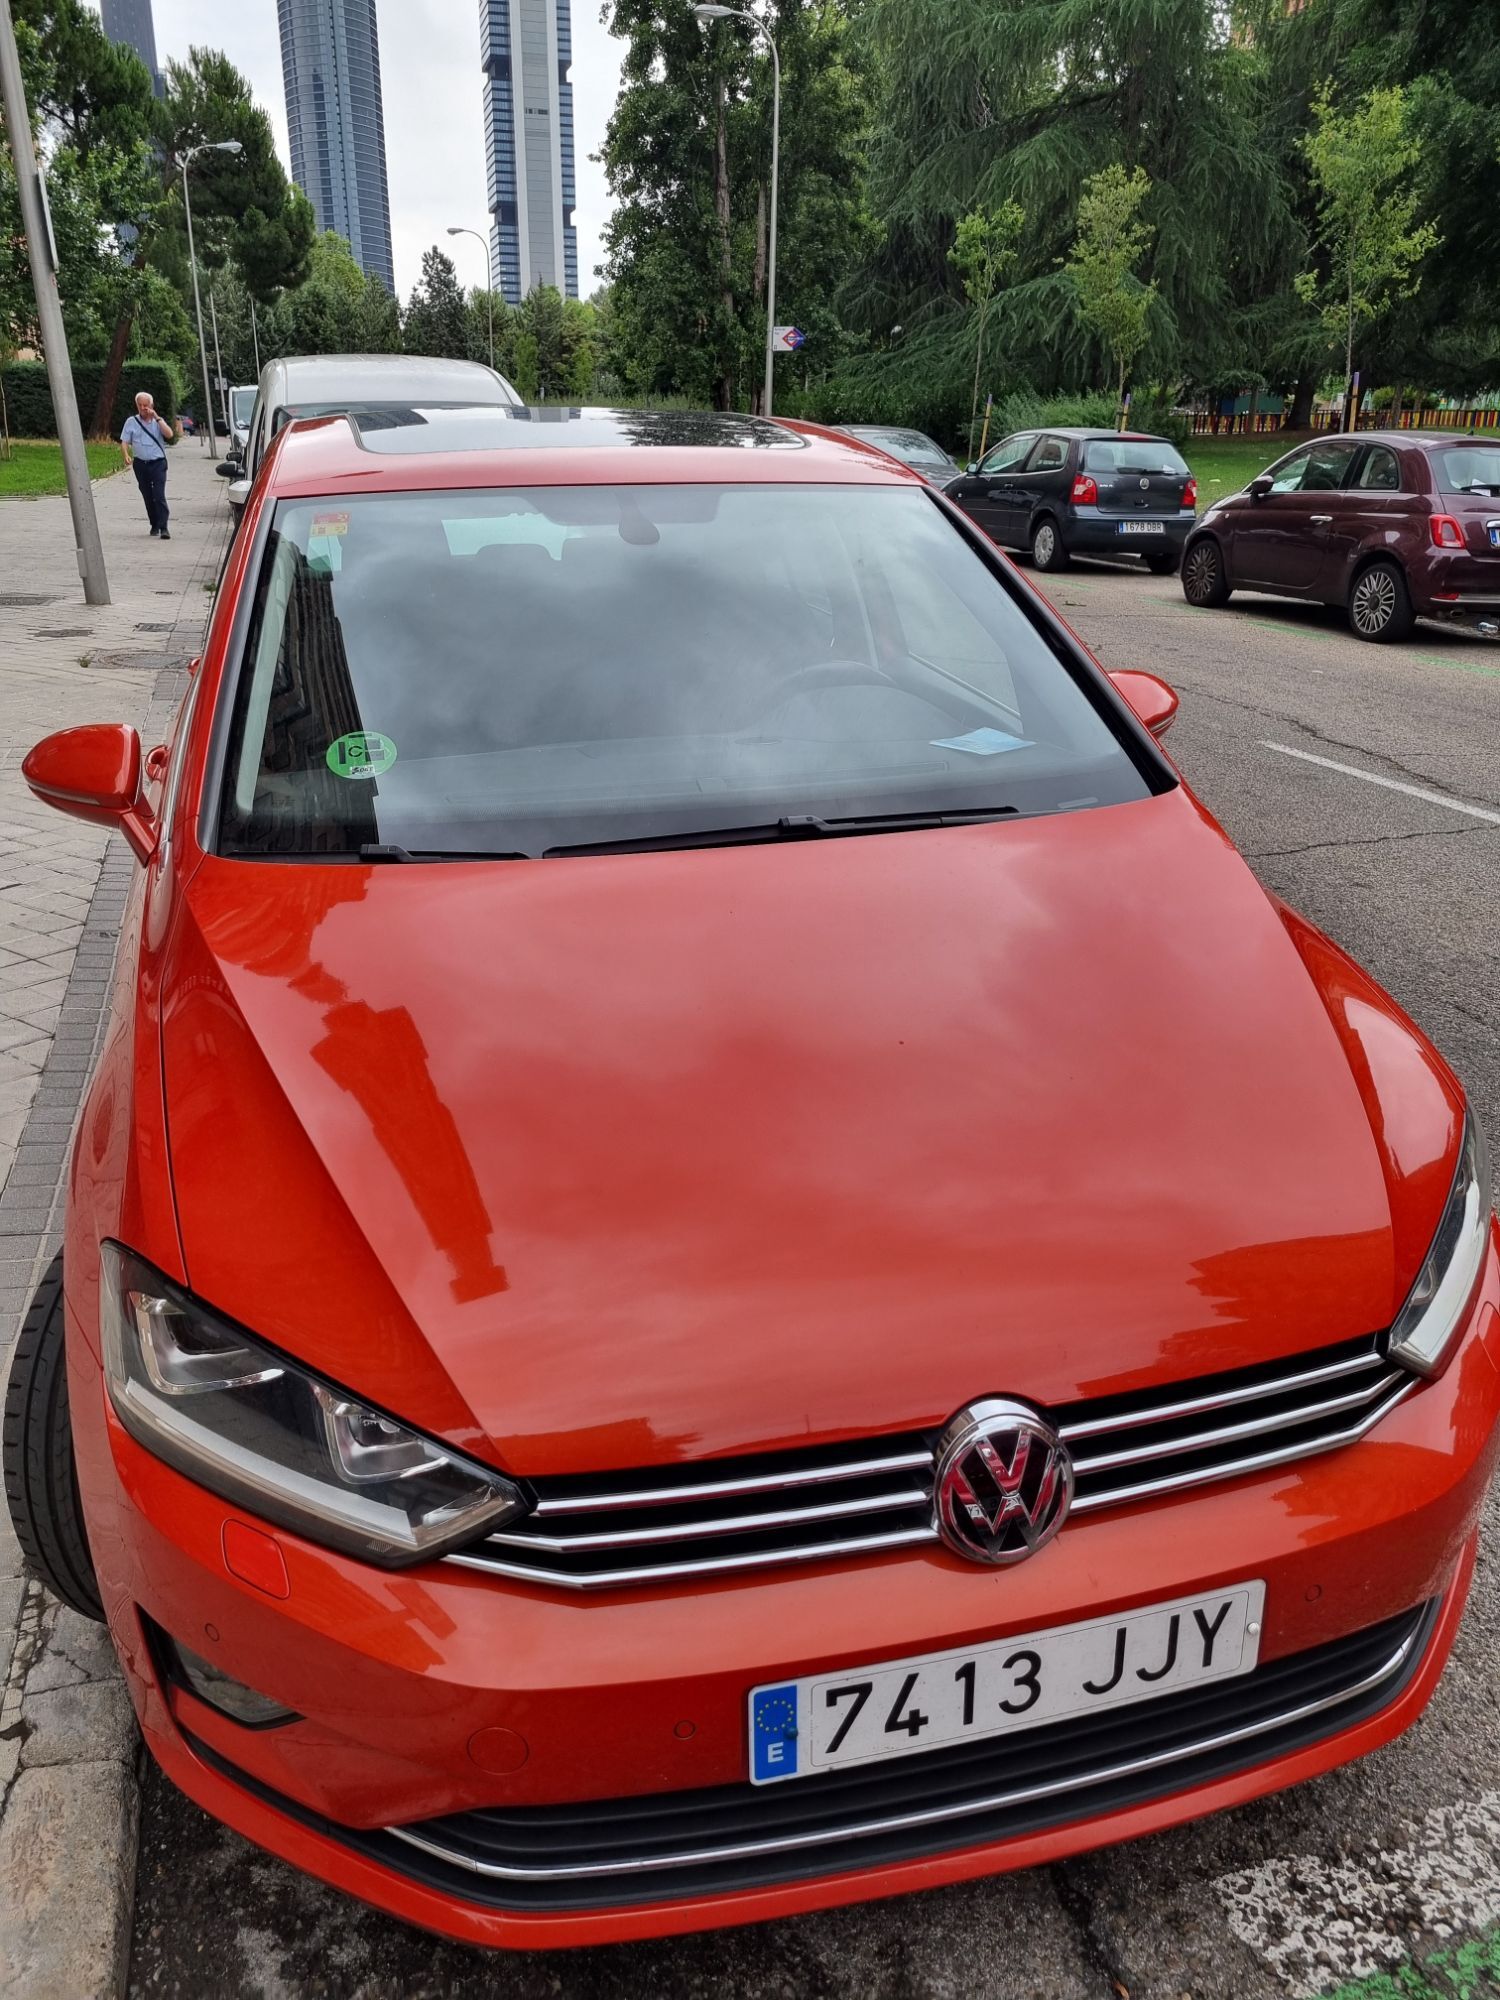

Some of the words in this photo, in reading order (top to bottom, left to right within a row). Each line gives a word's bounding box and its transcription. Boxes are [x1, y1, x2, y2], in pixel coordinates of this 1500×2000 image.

[348, 745, 363, 758] C
[825, 1650, 1043, 1754] 7413
[1082, 1600, 1234, 1696] JJY
[767, 1742, 784, 1764] E
